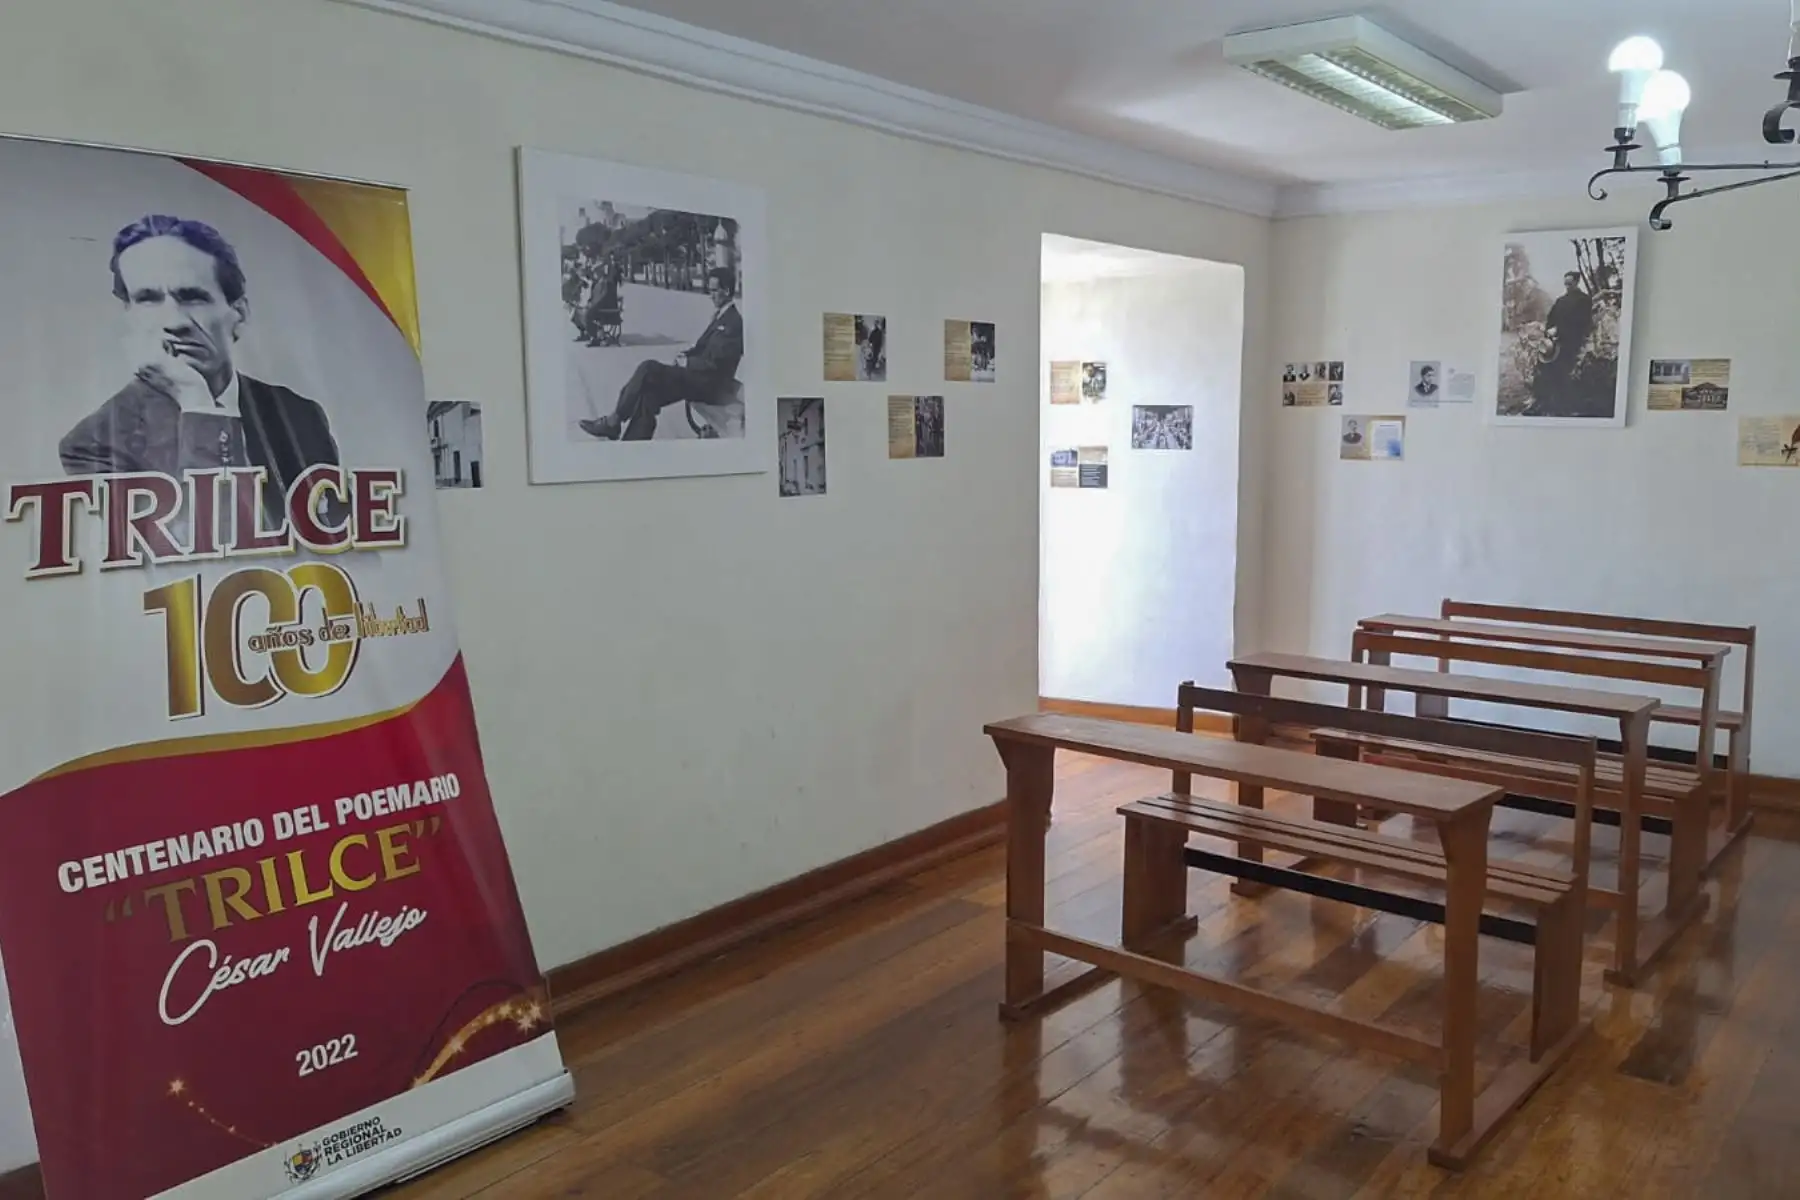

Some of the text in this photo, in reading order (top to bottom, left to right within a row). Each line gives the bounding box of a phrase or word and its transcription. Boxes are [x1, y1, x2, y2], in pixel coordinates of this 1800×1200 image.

[4, 463, 405, 579] TRILCE
[143, 561, 362, 722] 100
[248, 626, 314, 653] años
[318, 607, 350, 642] de
[58, 772, 461, 893] CENTENARIO DEL POEMARIO
[158, 902, 427, 1025] César Vallejo
[296, 1033, 358, 1076] 2022
[322, 1116, 381, 1146] GOBIERNO
[324, 1124, 387, 1157] REGIONAL
[327, 1127, 402, 1166] LA LIBERTAD
